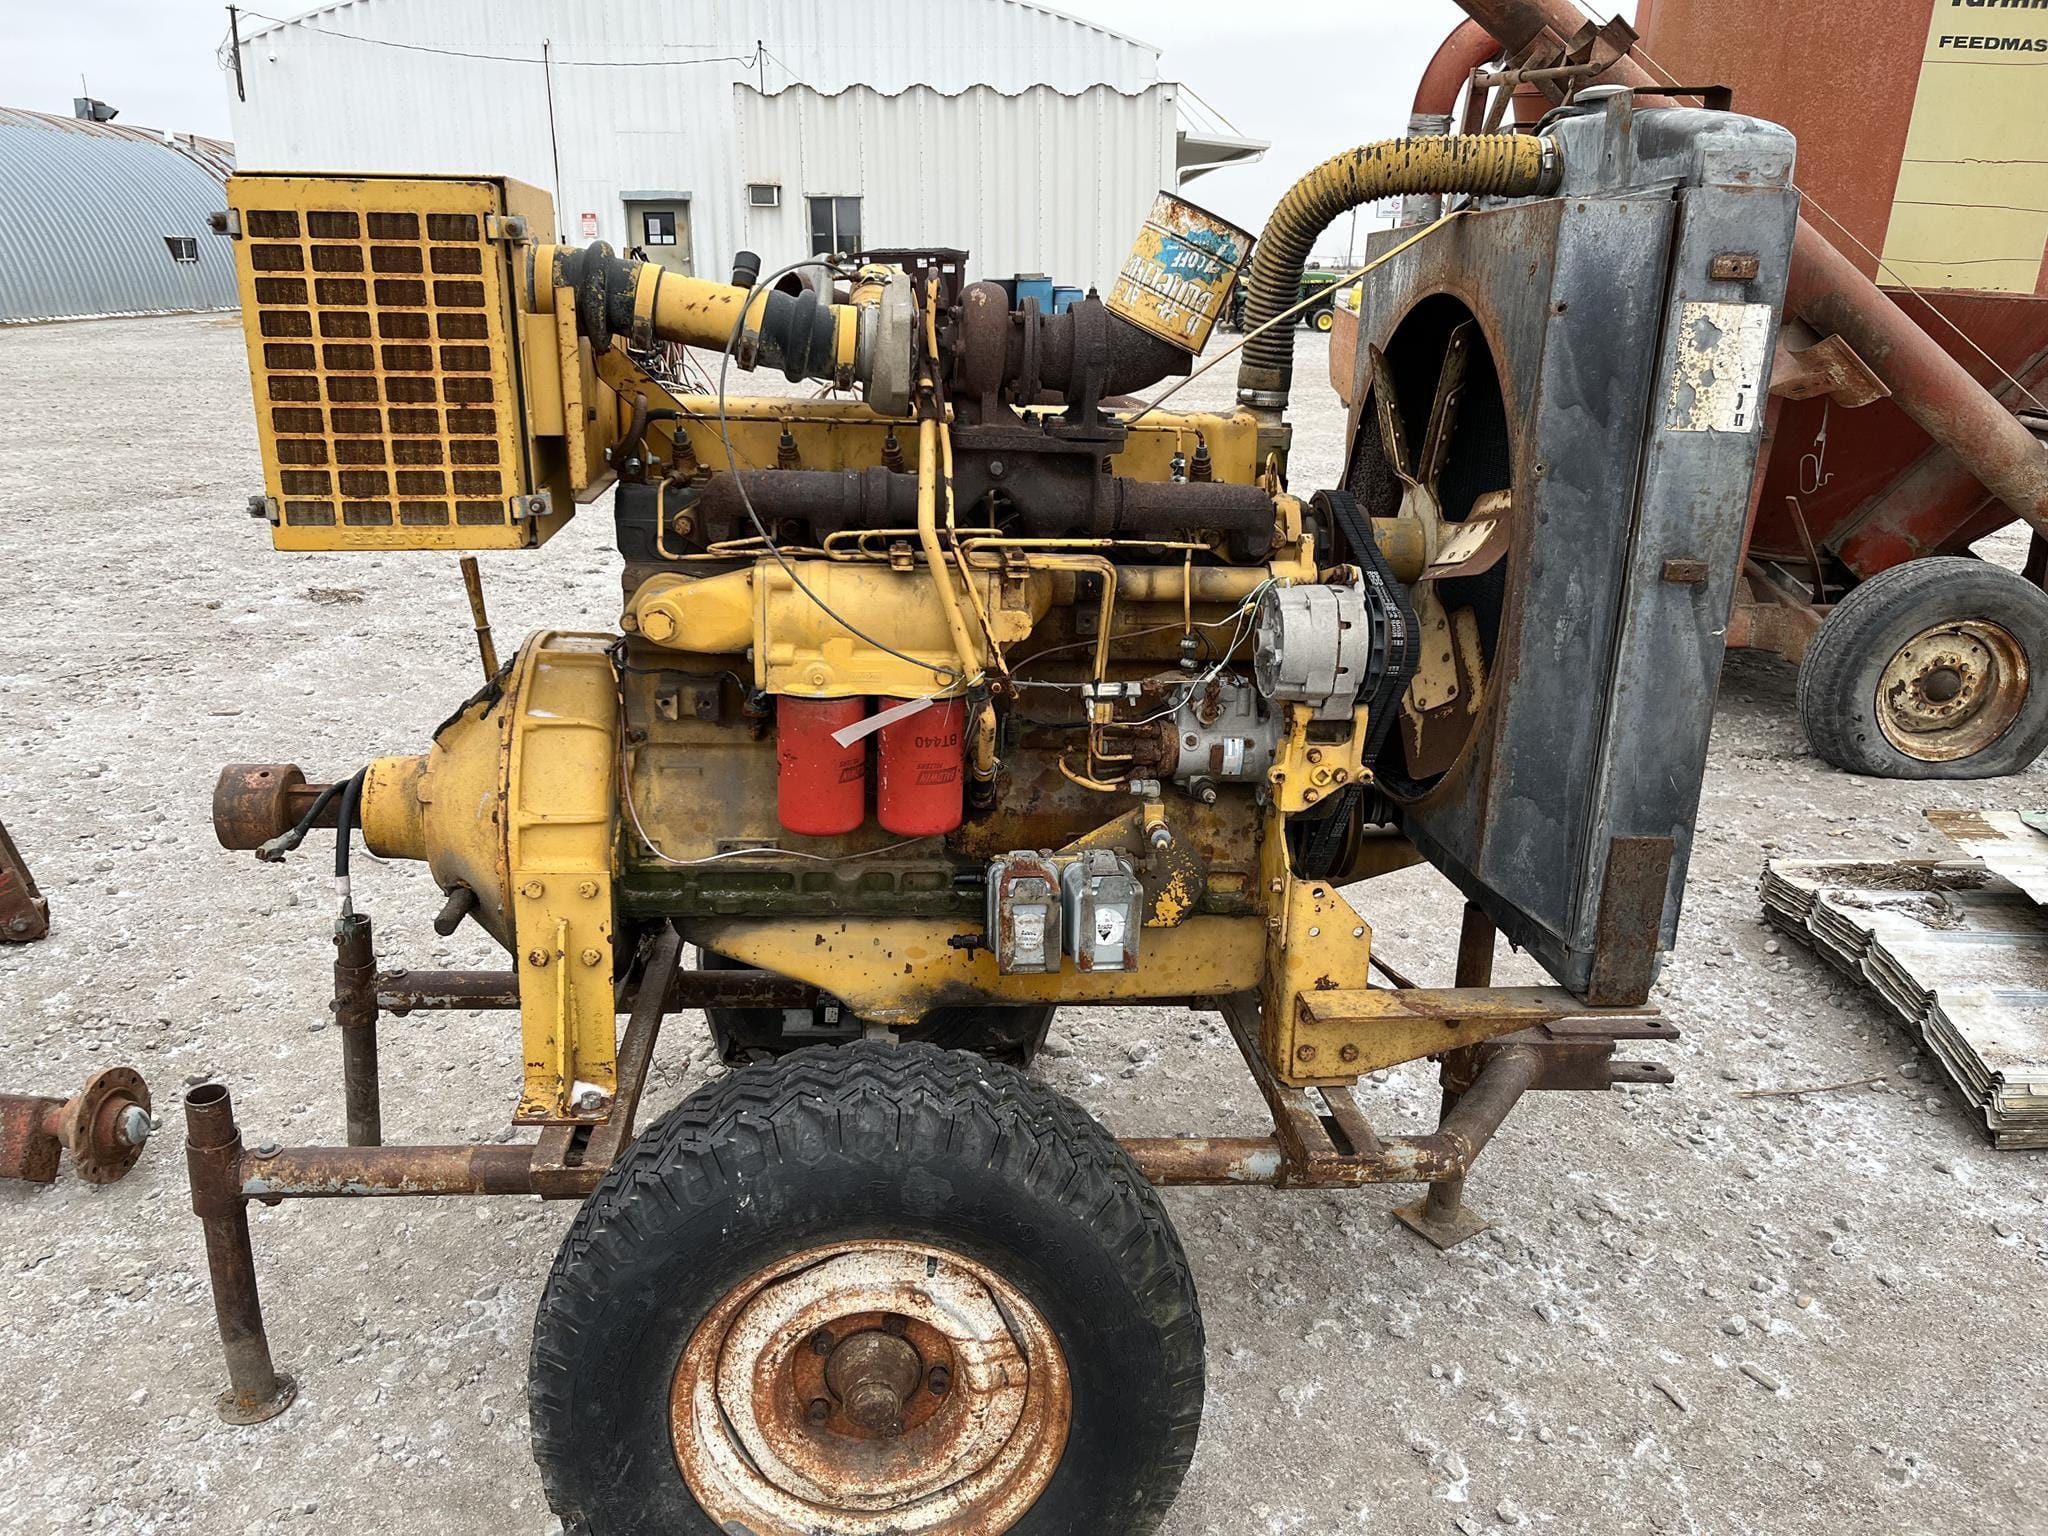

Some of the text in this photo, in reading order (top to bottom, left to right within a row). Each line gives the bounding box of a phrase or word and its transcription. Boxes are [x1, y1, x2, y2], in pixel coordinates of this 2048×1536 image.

[1939, 35, 2048, 52] FEEDMAS
[1171, 251, 1200, 268] OFF
[915, 734, 957, 748] BT440
